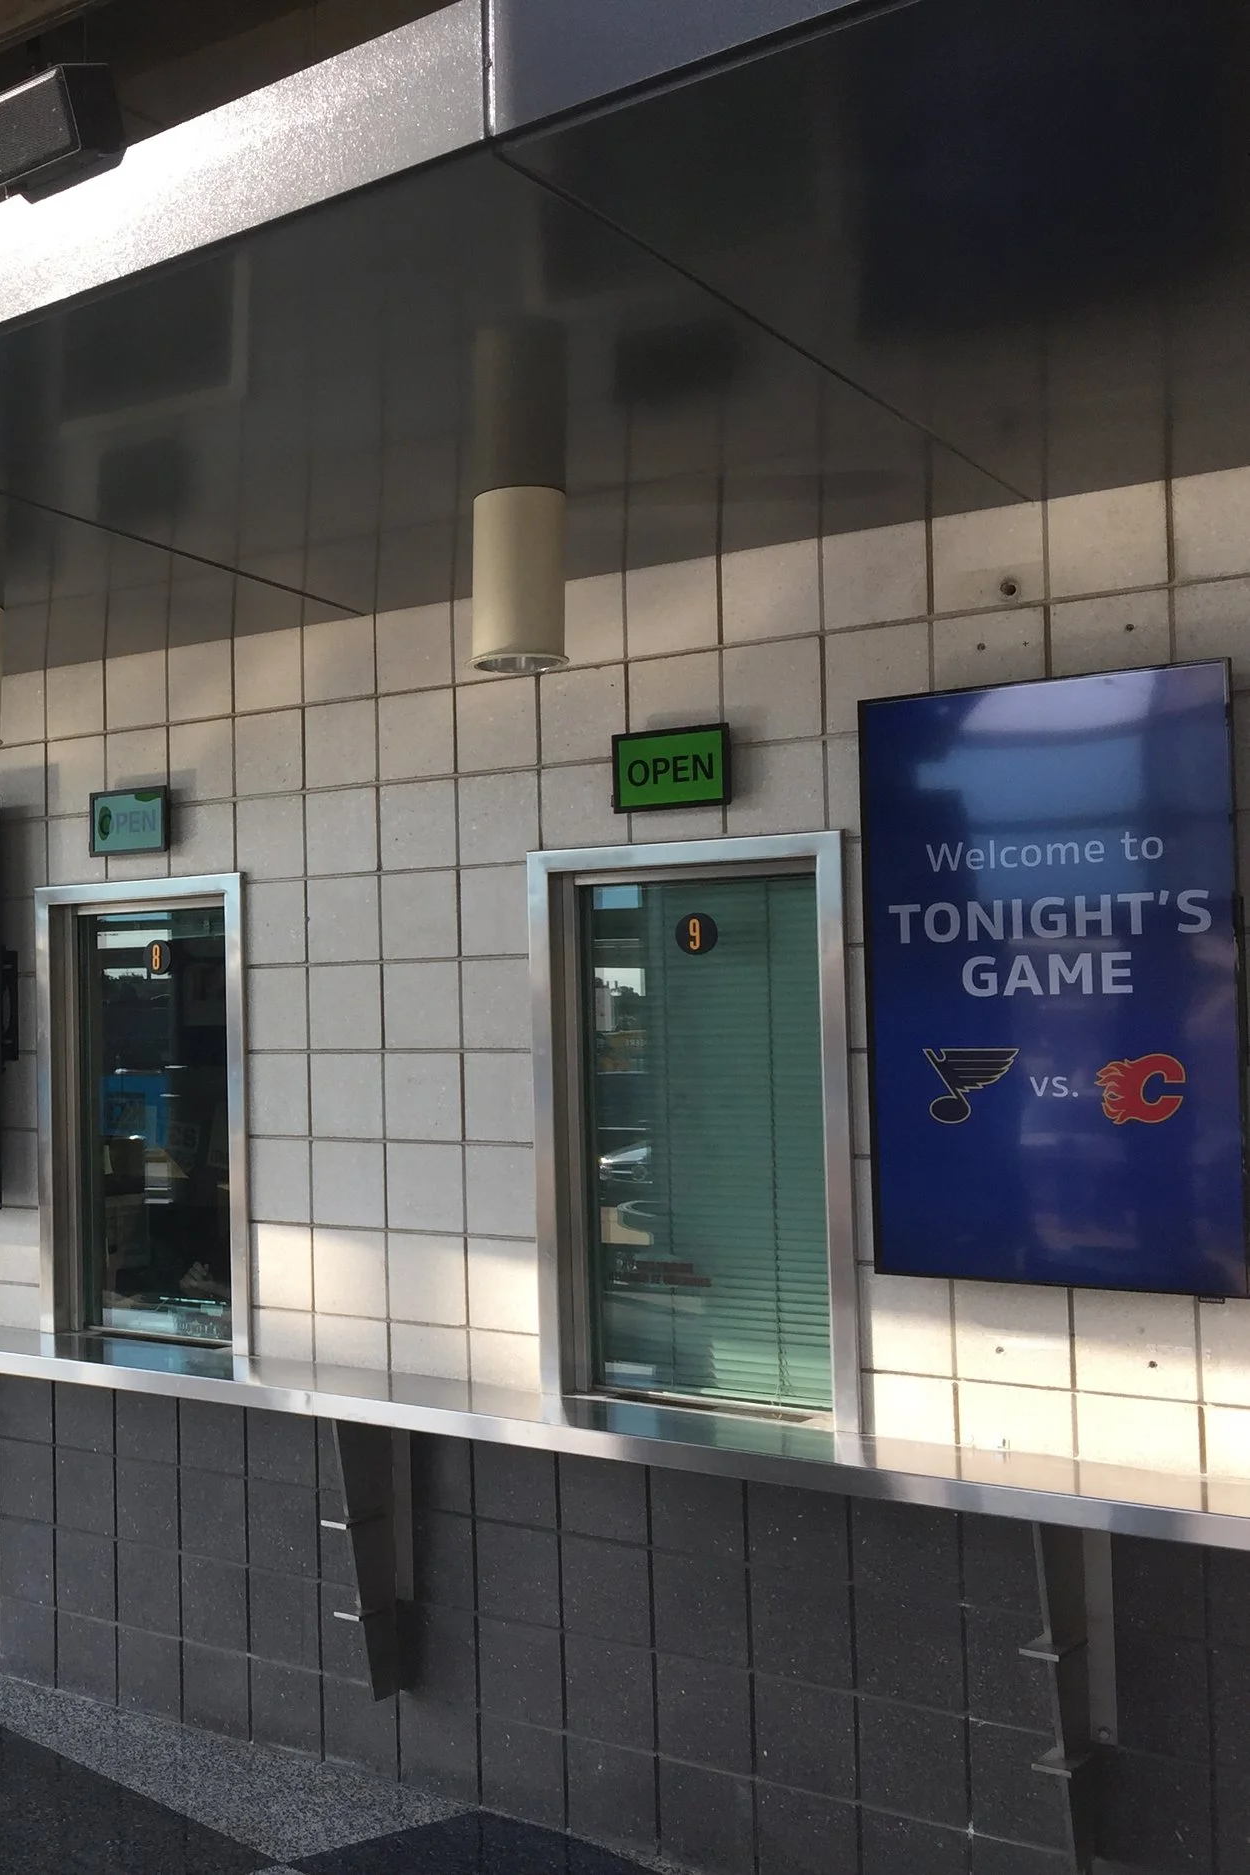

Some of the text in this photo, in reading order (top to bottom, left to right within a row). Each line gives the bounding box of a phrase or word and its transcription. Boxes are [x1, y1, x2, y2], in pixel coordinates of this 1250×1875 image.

[627, 752, 714, 787] OPEN
[98, 808, 157, 837] OPEN
[925, 831, 1164, 873] Welcome to
[888, 889, 1213, 944] TONIGHT'S
[689, 918, 701, 950] 9
[152, 943, 160, 971] 8
[961, 951, 1134, 998] GAME
[1029, 1076, 1079, 1098] vs.
